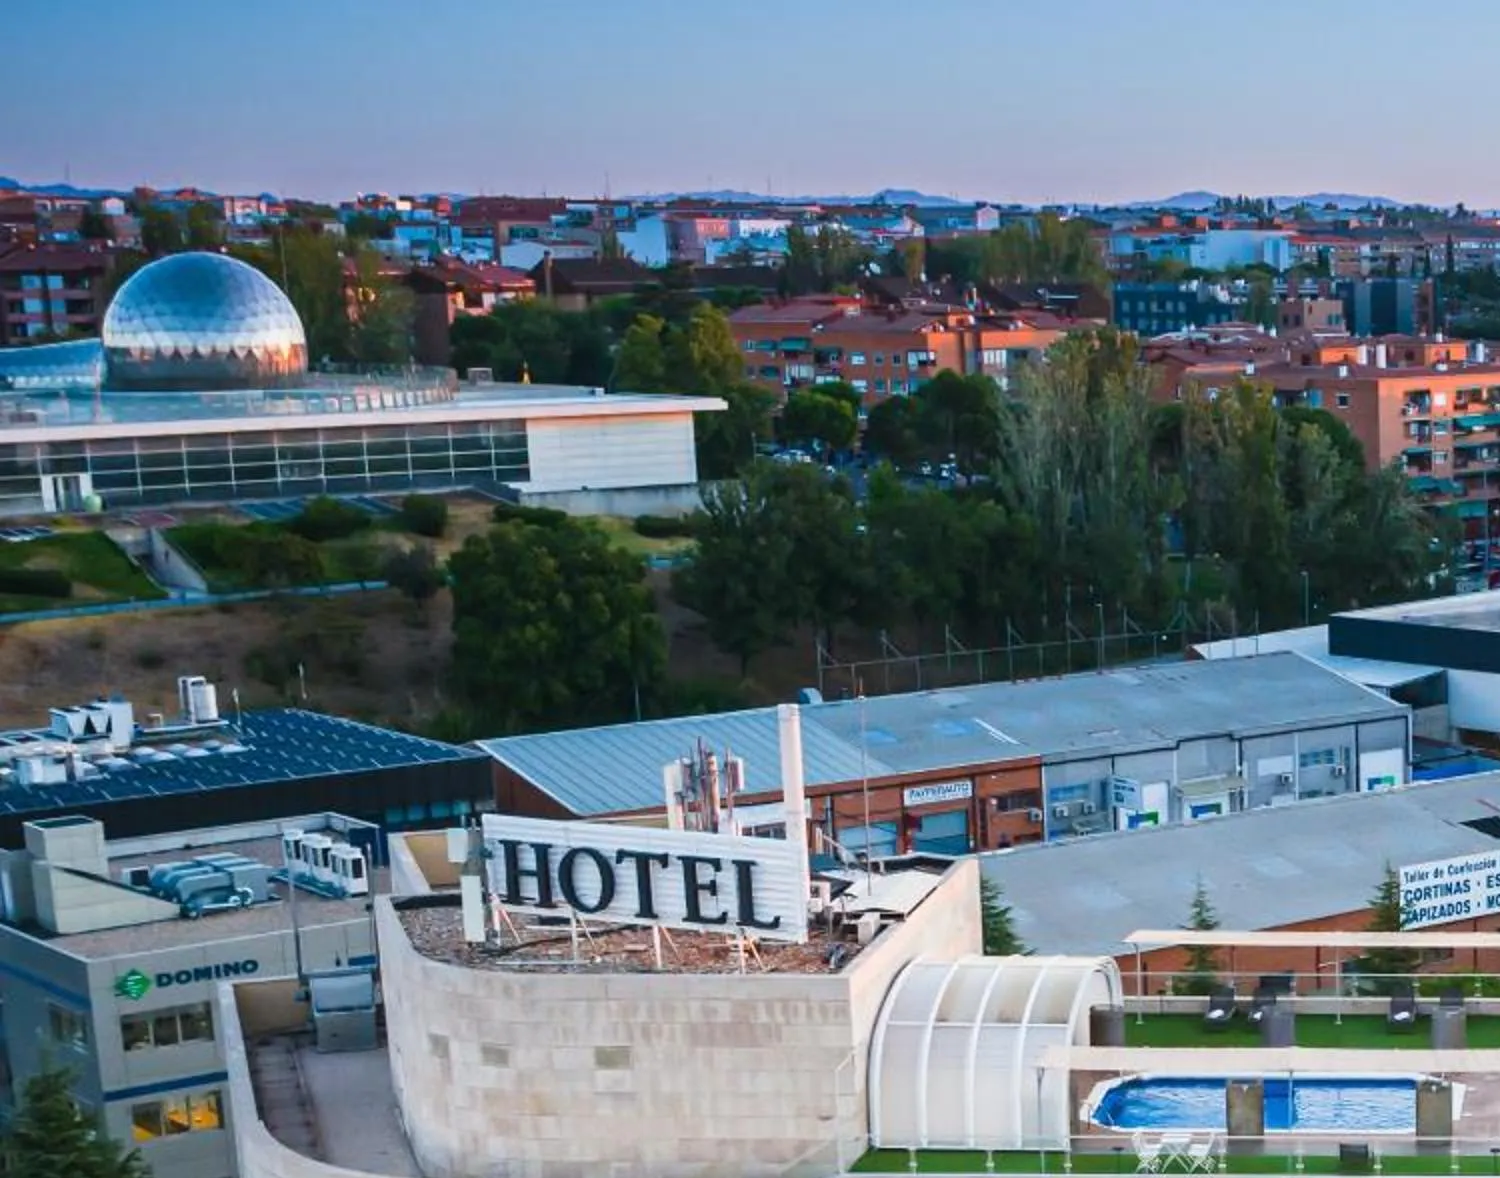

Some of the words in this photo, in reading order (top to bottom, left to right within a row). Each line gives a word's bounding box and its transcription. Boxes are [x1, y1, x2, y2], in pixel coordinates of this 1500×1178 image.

[498, 839, 781, 929] HOTEL
[1403, 871, 1430, 885] Taller
[1433, 867, 1445, 879] de
[1404, 879, 1471, 904] CORTINAS
[1403, 899, 1471, 924] TAPIZADOS
[155, 959, 259, 988] DOMINO
